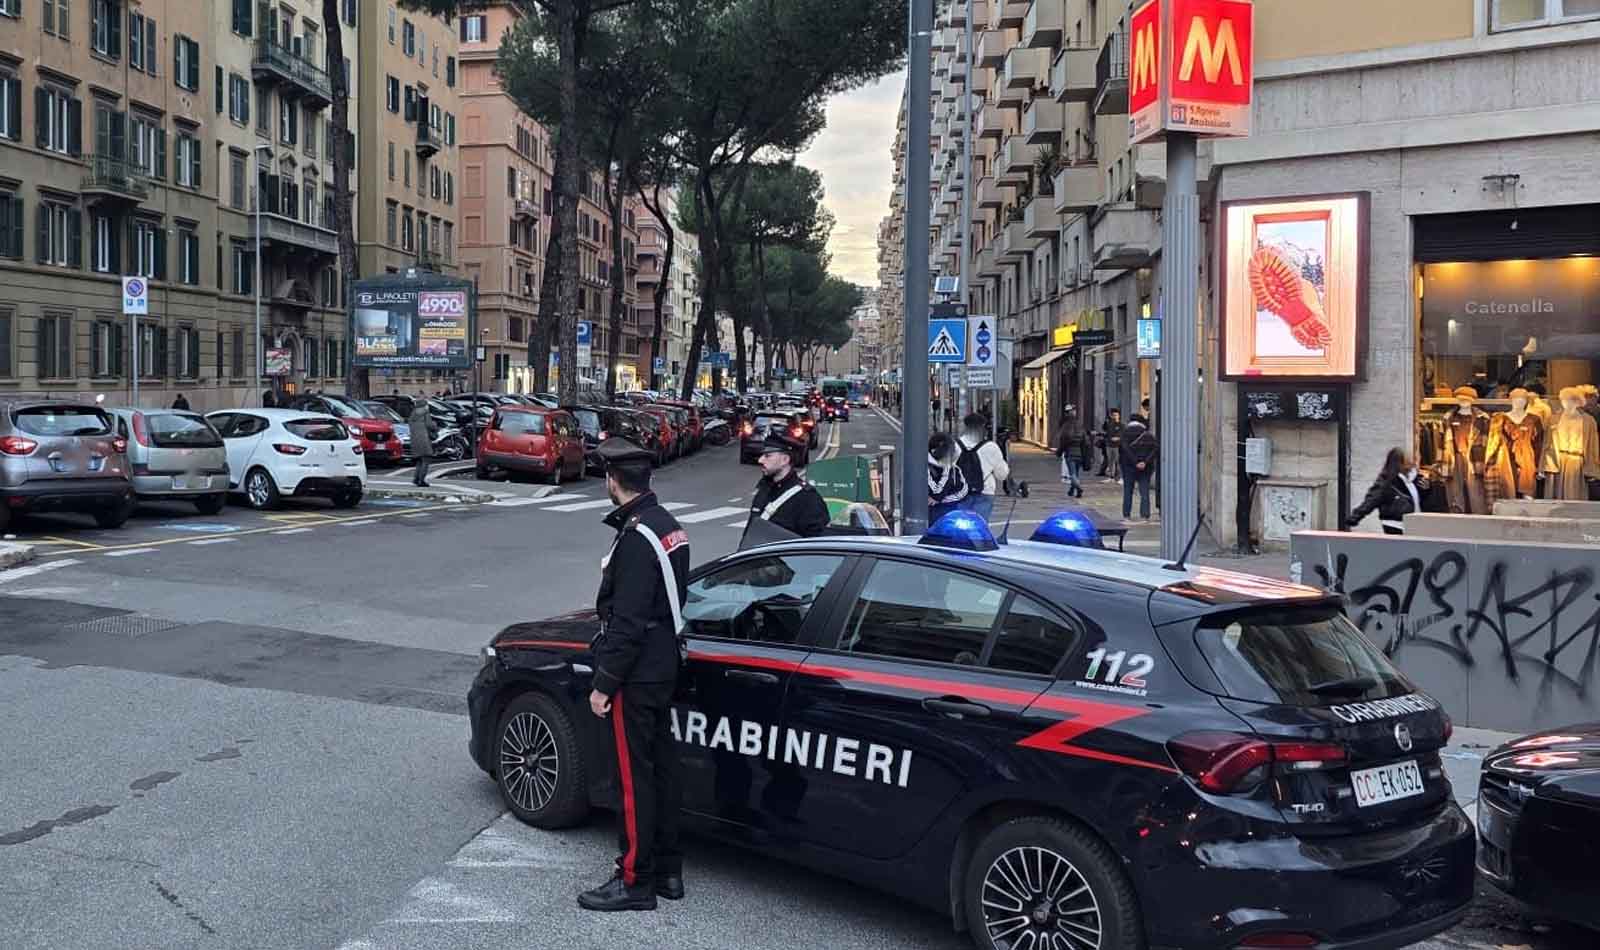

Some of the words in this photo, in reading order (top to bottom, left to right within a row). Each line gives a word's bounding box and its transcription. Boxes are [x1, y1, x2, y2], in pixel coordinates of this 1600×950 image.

[1131, 21, 1157, 97] M
[1178, 15, 1244, 86] M
[1464, 298, 1554, 314] Catenella
[1085, 648, 1154, 688] 112
[1330, 693, 1436, 723] CARABINIERI
[669, 707, 913, 788] ARABINIERI
[1355, 774, 1376, 801] CC
